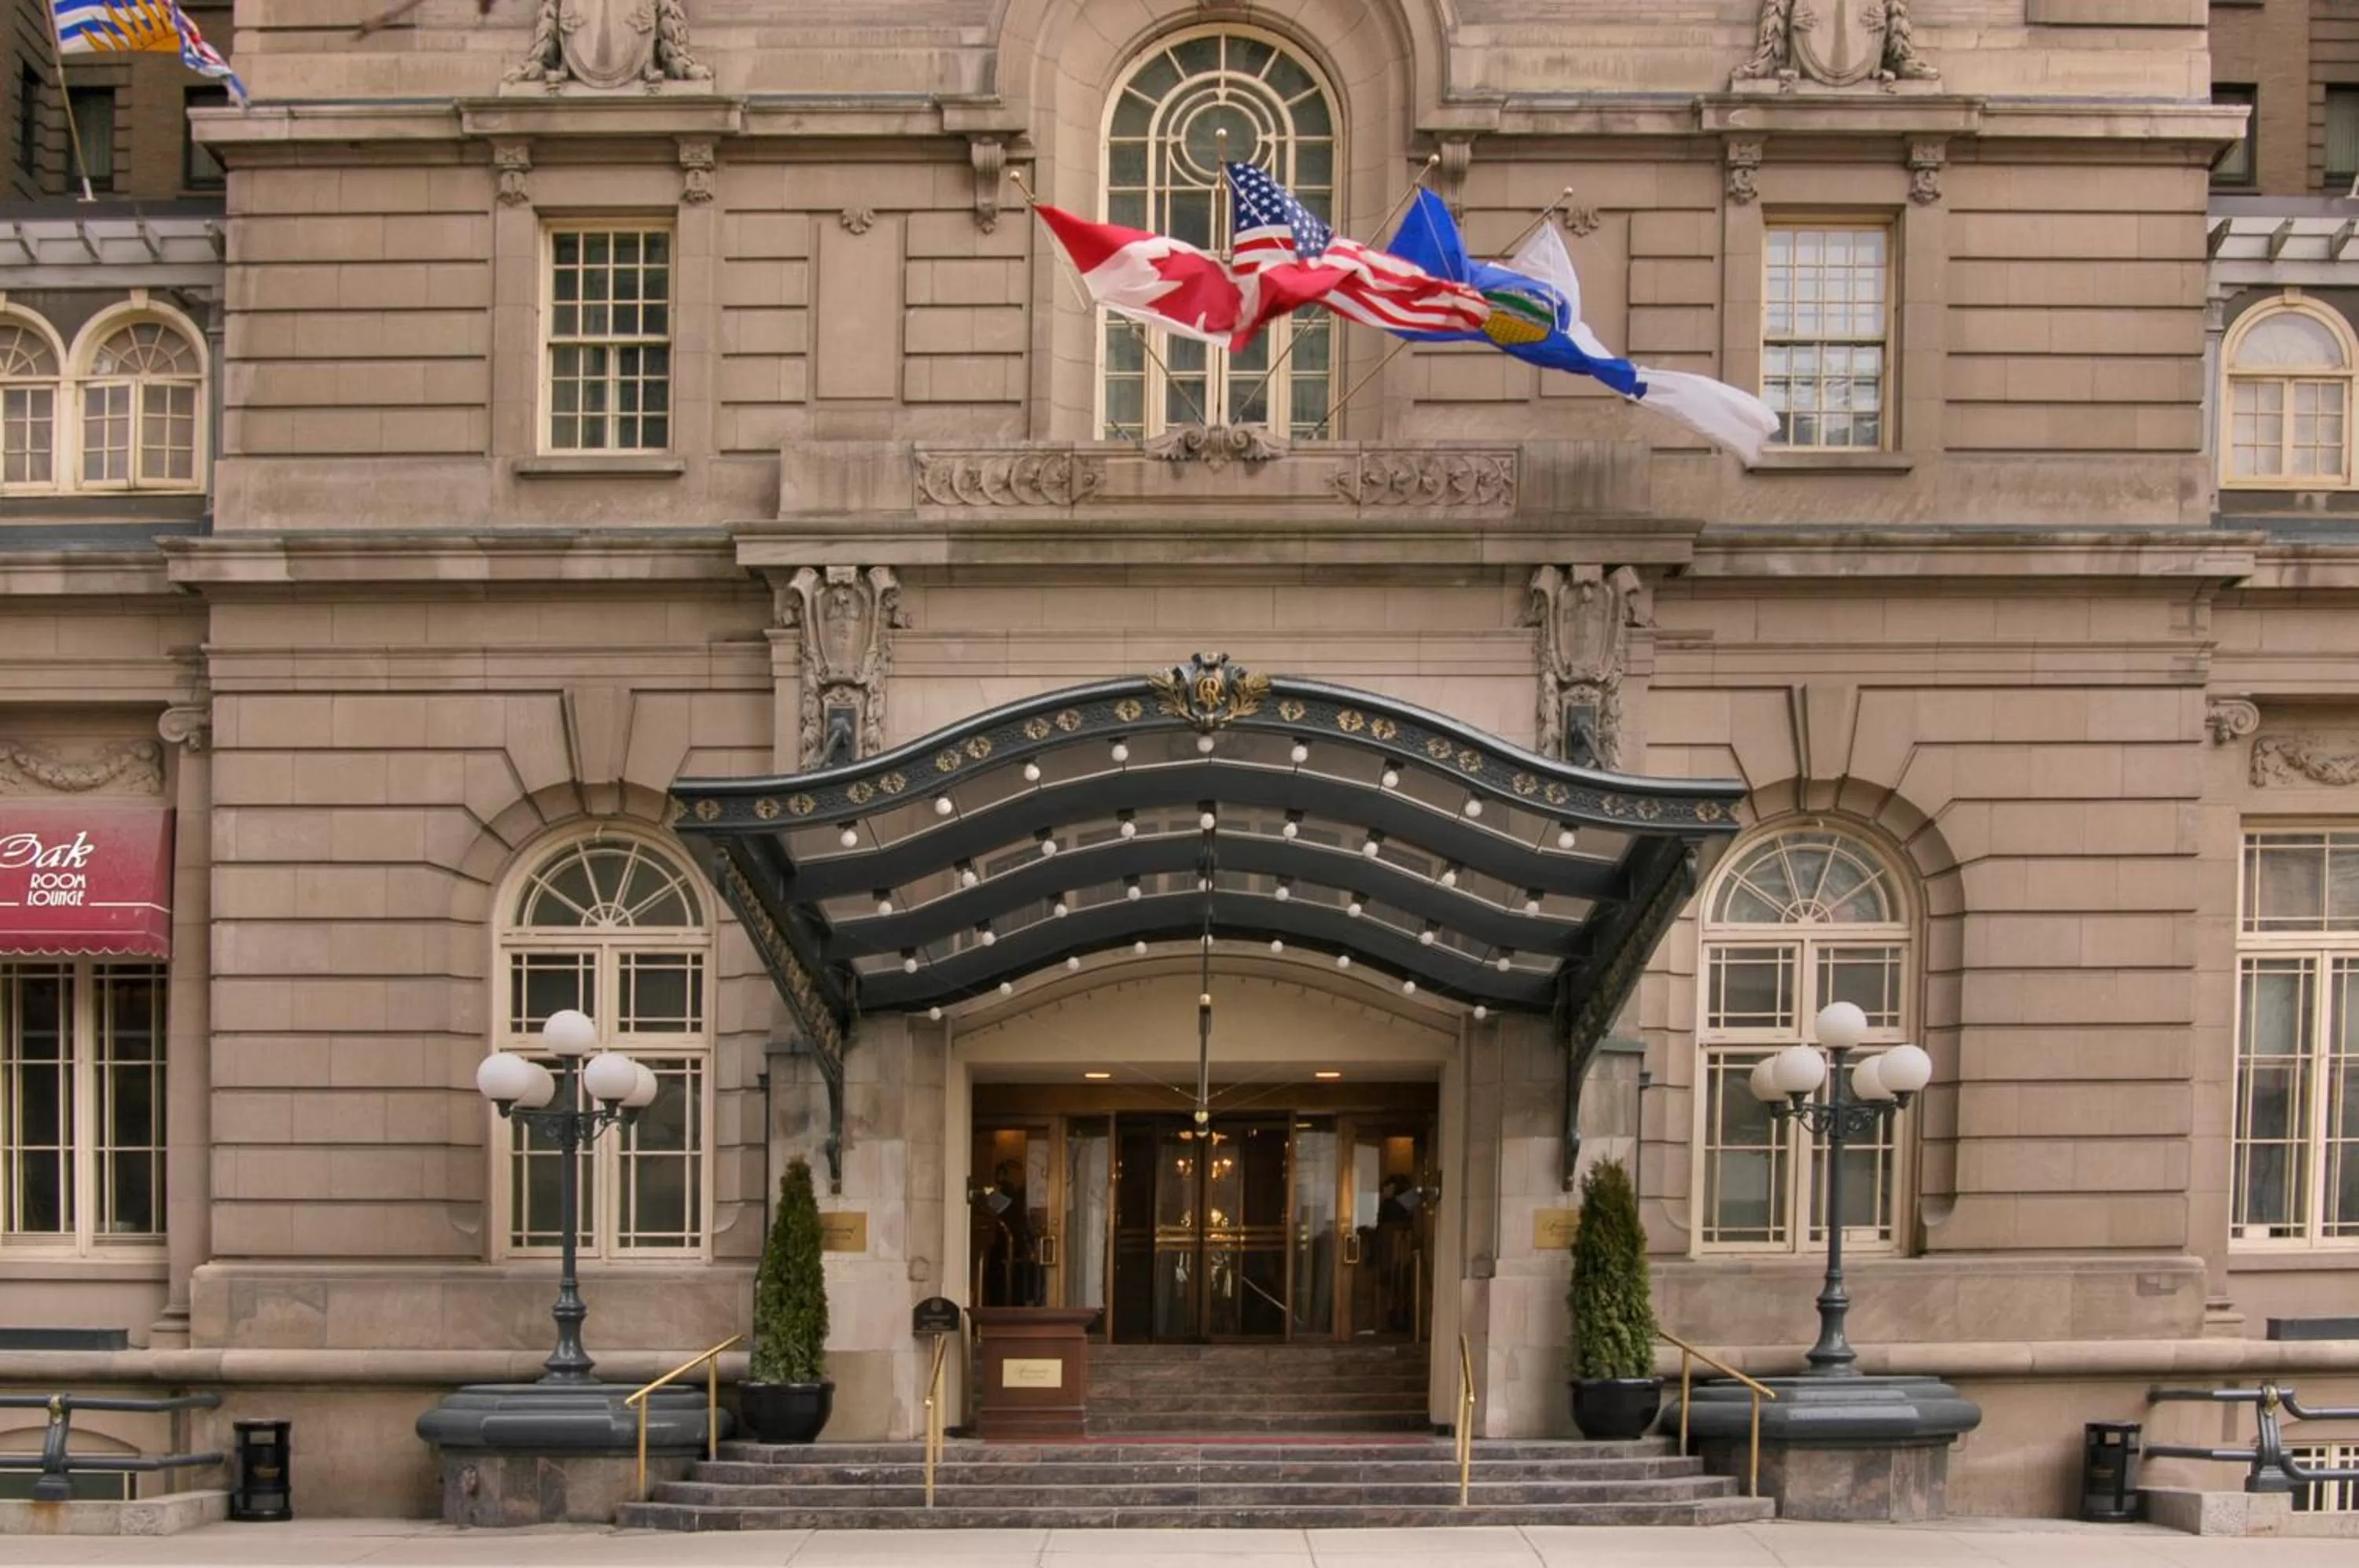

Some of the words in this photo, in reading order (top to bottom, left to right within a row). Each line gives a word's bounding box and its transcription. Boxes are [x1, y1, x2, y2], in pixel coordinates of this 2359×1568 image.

[0, 830, 94, 868] Oak
[30, 873, 86, 889] ROOM
[27, 890, 85, 907] LOUNGE
